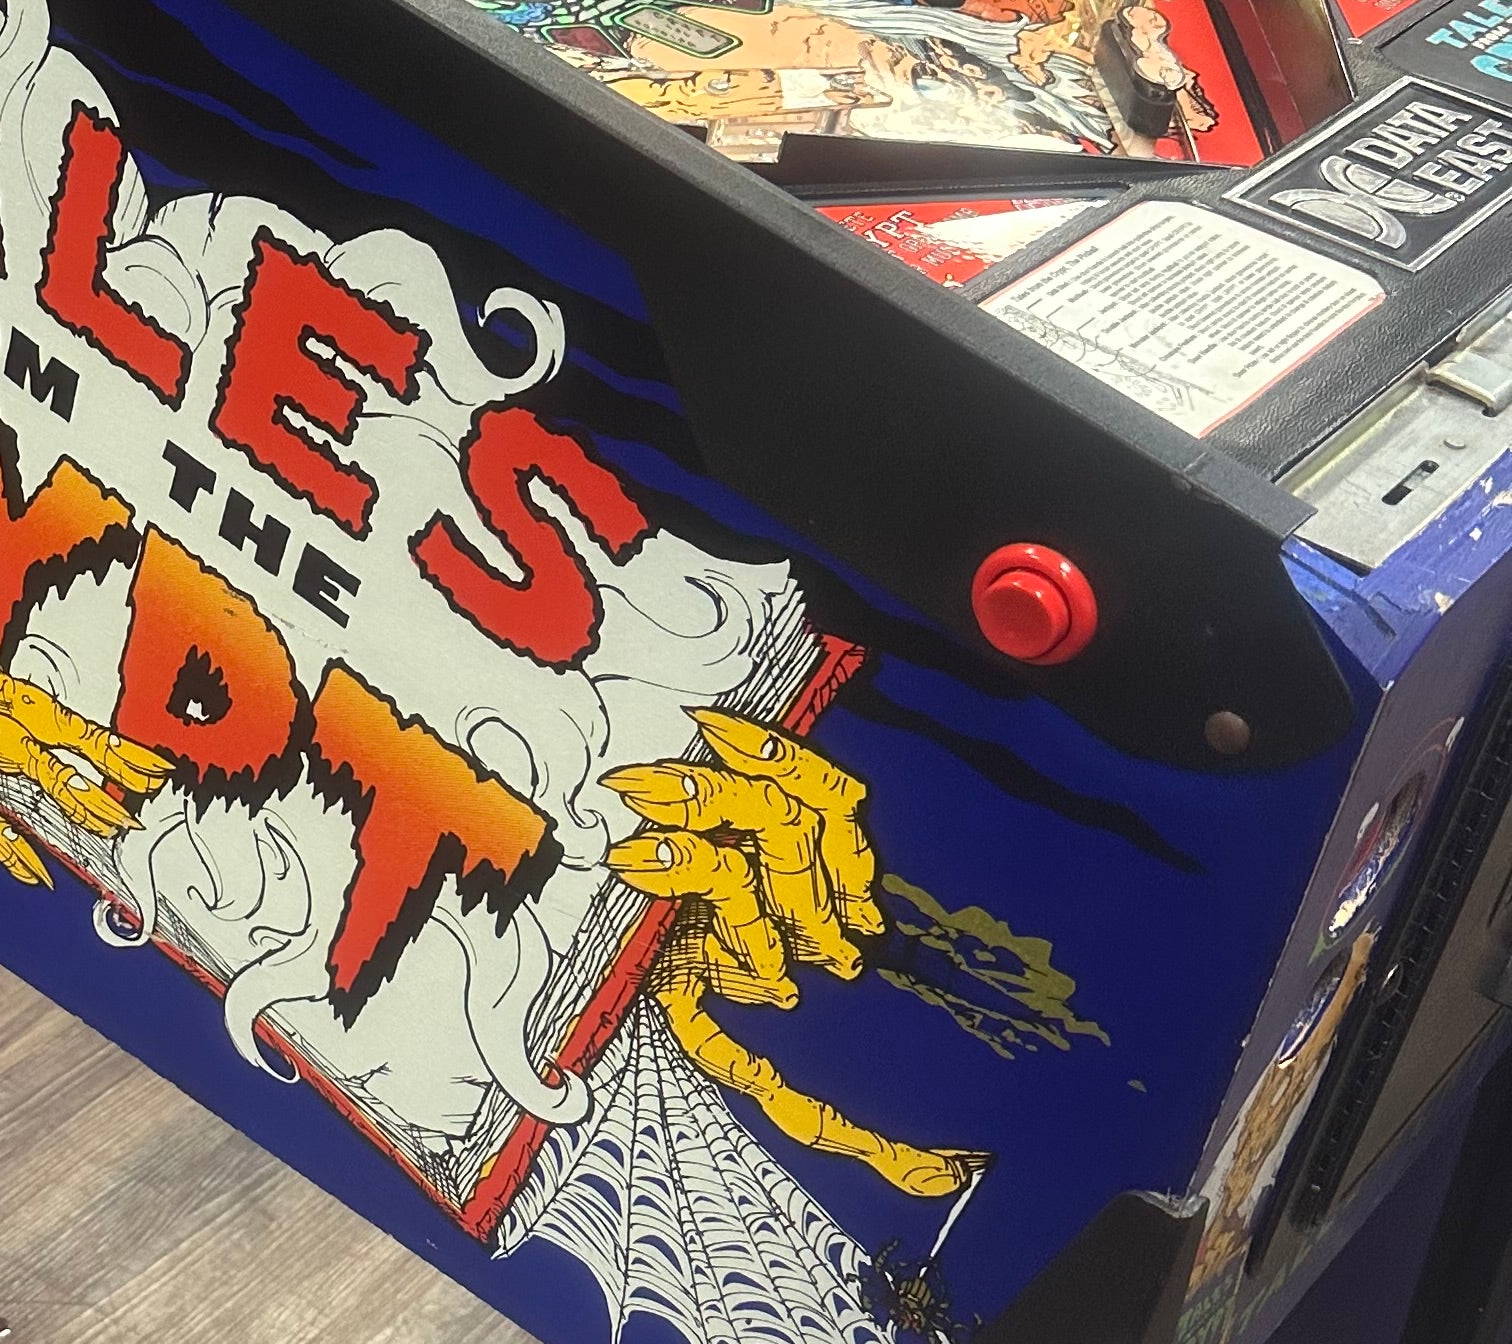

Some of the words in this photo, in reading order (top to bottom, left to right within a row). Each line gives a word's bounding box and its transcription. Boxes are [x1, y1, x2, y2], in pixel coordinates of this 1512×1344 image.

[1343, 101, 1473, 170] DATA
[1412, 118, 1512, 197] EAST
[862, 209, 924, 248] YPT
[1010, 289, 1032, 303] Tales
[1025, 281, 1045, 292] from
[1038, 274, 1055, 284] the
[1064, 257, 1081, 267] The
[1075, 245, 1100, 260] Pinball
[162, 439, 362, 629] THE
